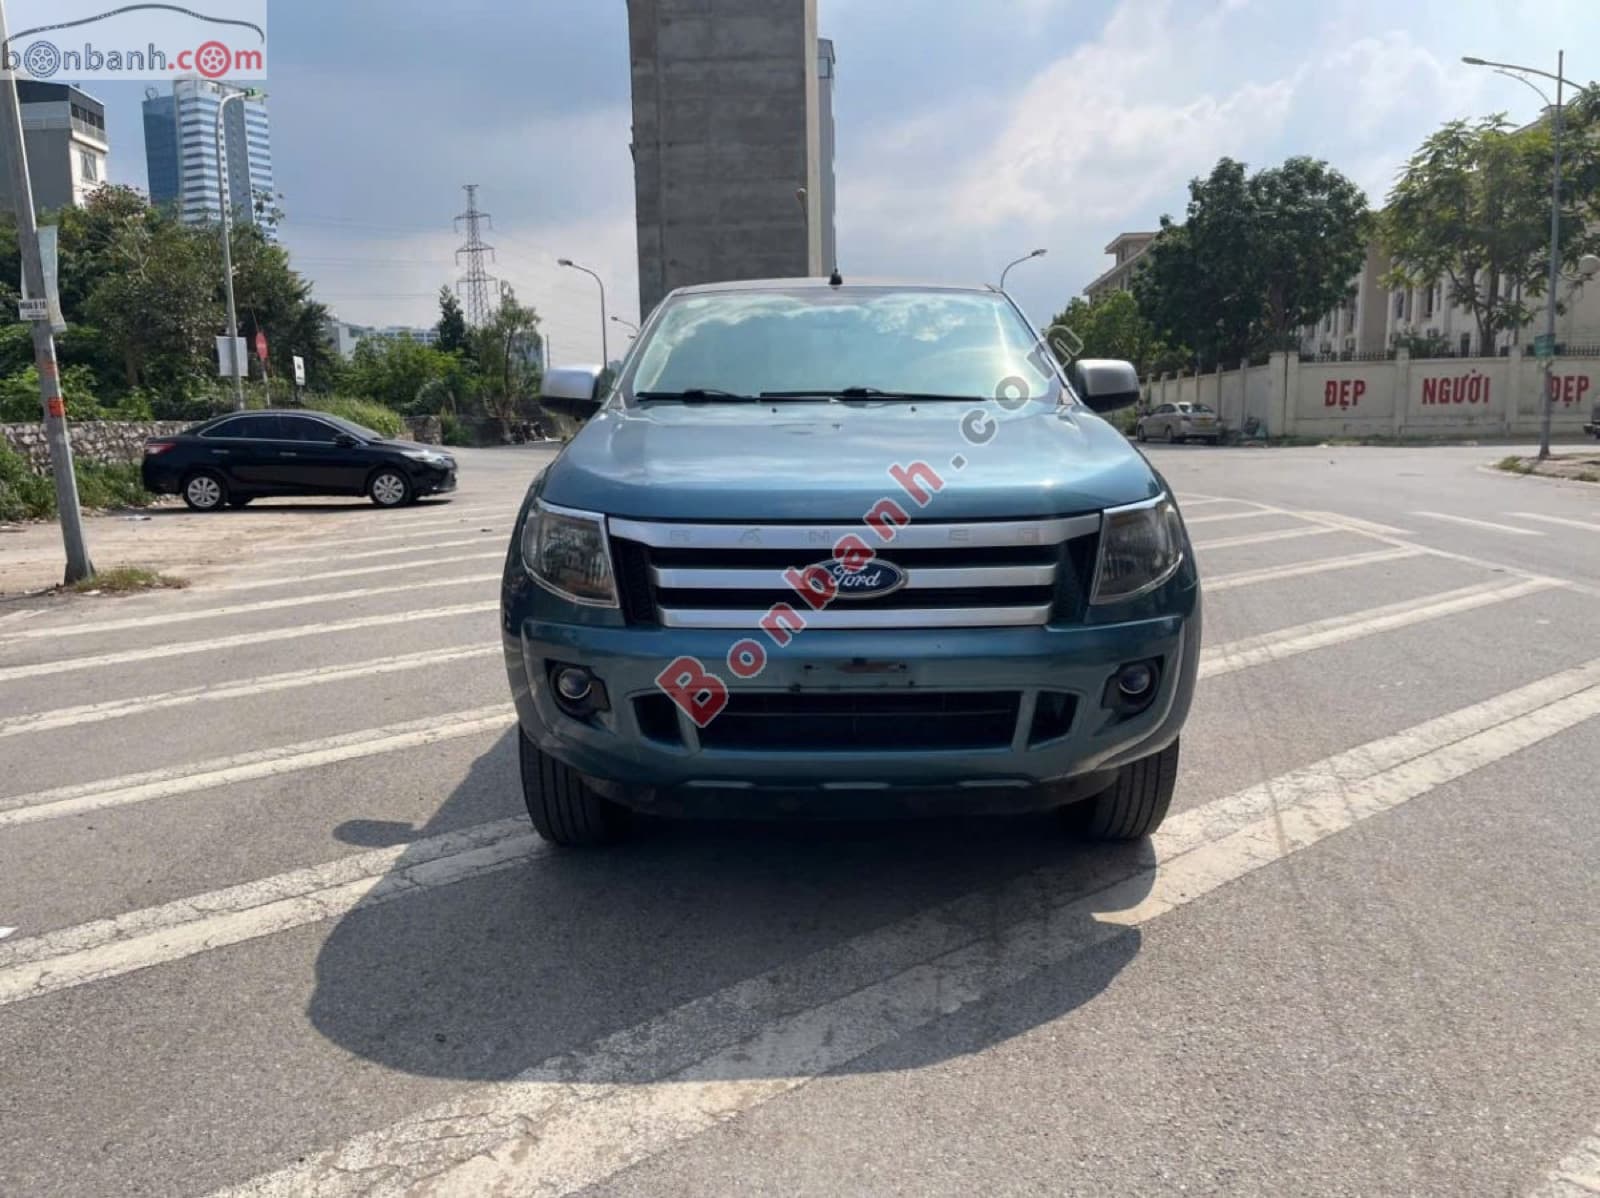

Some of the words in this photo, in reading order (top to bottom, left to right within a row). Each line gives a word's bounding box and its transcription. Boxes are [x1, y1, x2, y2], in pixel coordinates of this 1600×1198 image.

[1324, 380, 1366, 410] ĐẸP
[1421, 369, 1490, 405] NGƯỜI
[669, 528, 1041, 546] RANER
[828, 564, 881, 587] Ford
